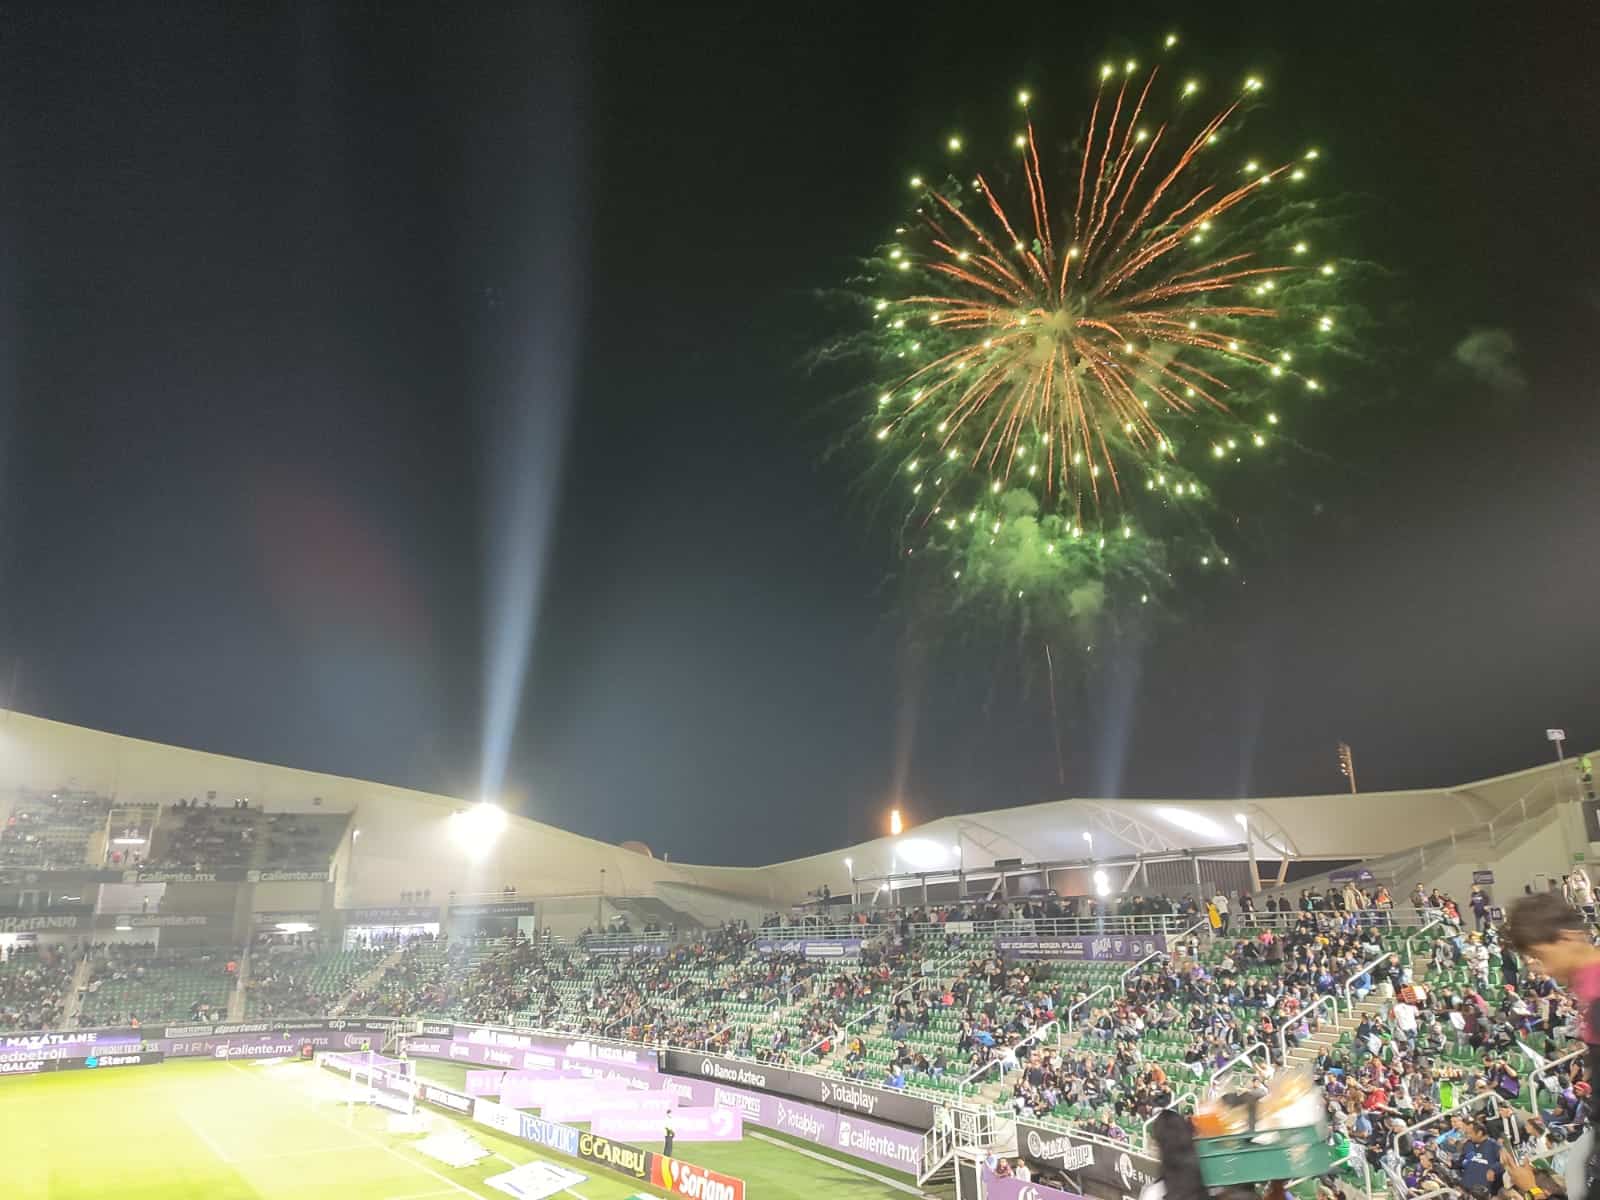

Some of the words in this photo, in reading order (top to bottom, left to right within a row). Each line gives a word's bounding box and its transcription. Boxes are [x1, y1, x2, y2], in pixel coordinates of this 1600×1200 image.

[172, 1041, 215, 1053] PIRM
[228, 1042, 293, 1057] caliente.mx
[714, 1063, 738, 1081] Banco
[737, 1068, 766, 1088] Azteca
[832, 1082, 875, 1114] Totalplay
[786, 1108, 821, 1142] Totalplay
[850, 1130, 918, 1165] caliente.mx
